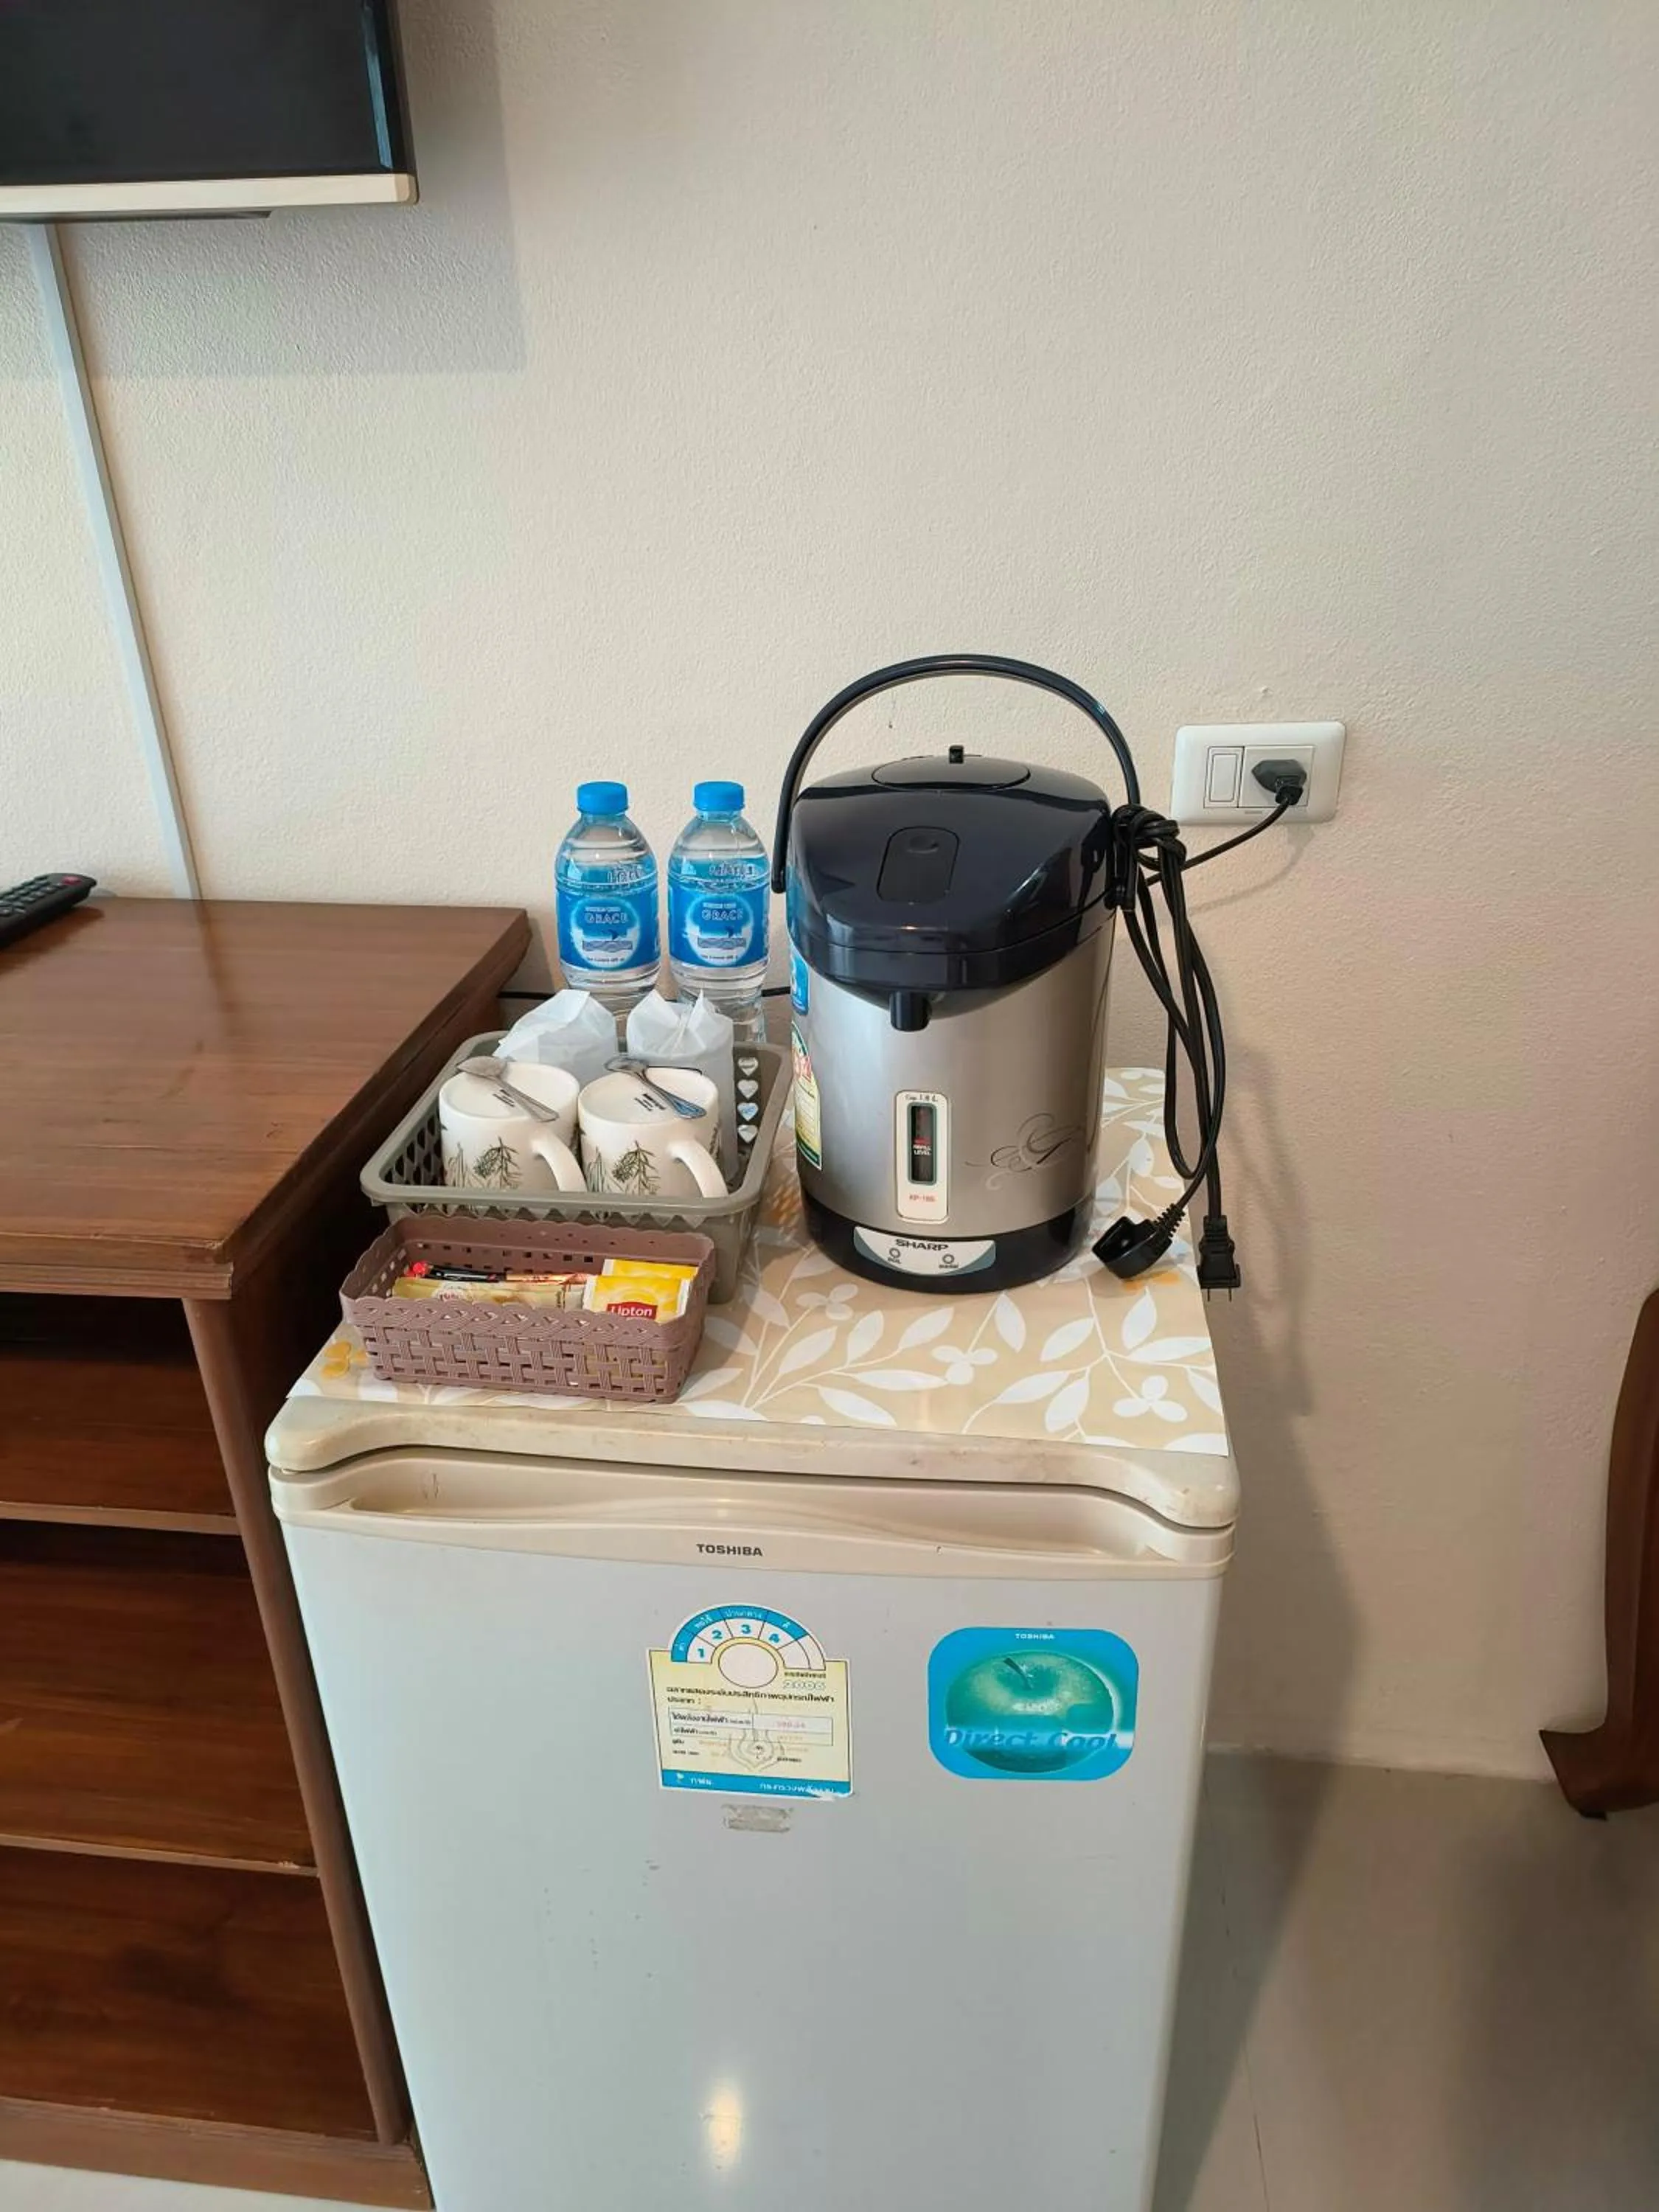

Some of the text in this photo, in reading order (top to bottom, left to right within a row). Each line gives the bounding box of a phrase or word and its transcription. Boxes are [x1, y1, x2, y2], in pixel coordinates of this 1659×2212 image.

[895, 1239, 949, 1251] SHARP
[695, 1543, 763, 1557] TOSHIBA
[712, 1630, 723, 1639] 2
[740, 1624, 751, 1634] 3
[768, 1632, 779, 1643] 4
[698, 1647, 705, 1658] 1
[945, 1728, 1119, 1750] Direct Cool
